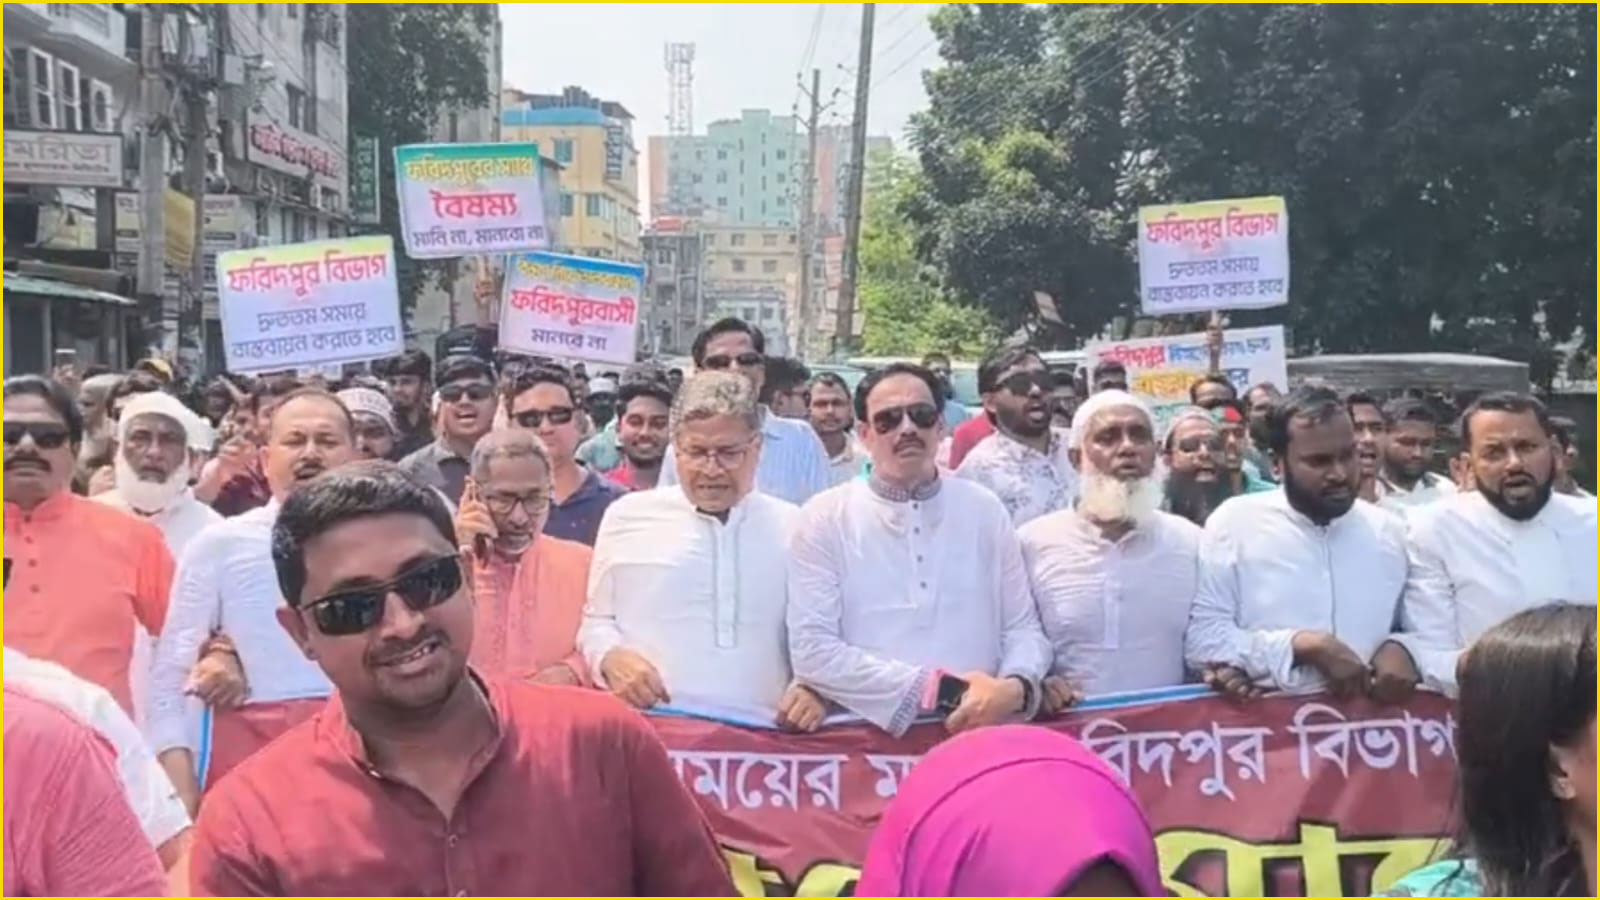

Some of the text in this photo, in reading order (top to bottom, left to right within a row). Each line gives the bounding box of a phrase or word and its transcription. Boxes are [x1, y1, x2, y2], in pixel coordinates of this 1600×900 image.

[430, 189, 518, 218] বৈষম্য
[412, 225, 447, 247] মানি
[475, 226, 525, 245] মানবো
[527, 225, 545, 240] না
[1146, 207, 1280, 248] ফরিদপুর বিভাগ
[227, 250, 388, 297] ফরিদপুর বিভাগ
[1168, 256, 1260, 280] দ্রুততম সময়ে
[511, 284, 636, 326] ফরিদপুরবাসী
[1149, 277, 1285, 303] বাস্তবায়ন করতে হবে
[257, 302, 367, 333] দ্রুততম সময়ে
[232, 325, 397, 359] বাস্তবায়ন করতে হবে
[531, 328, 608, 351] মানবে না
[1080, 717, 1275, 802] রিদপুর
[1287, 702, 1459, 781] বিভাগ
